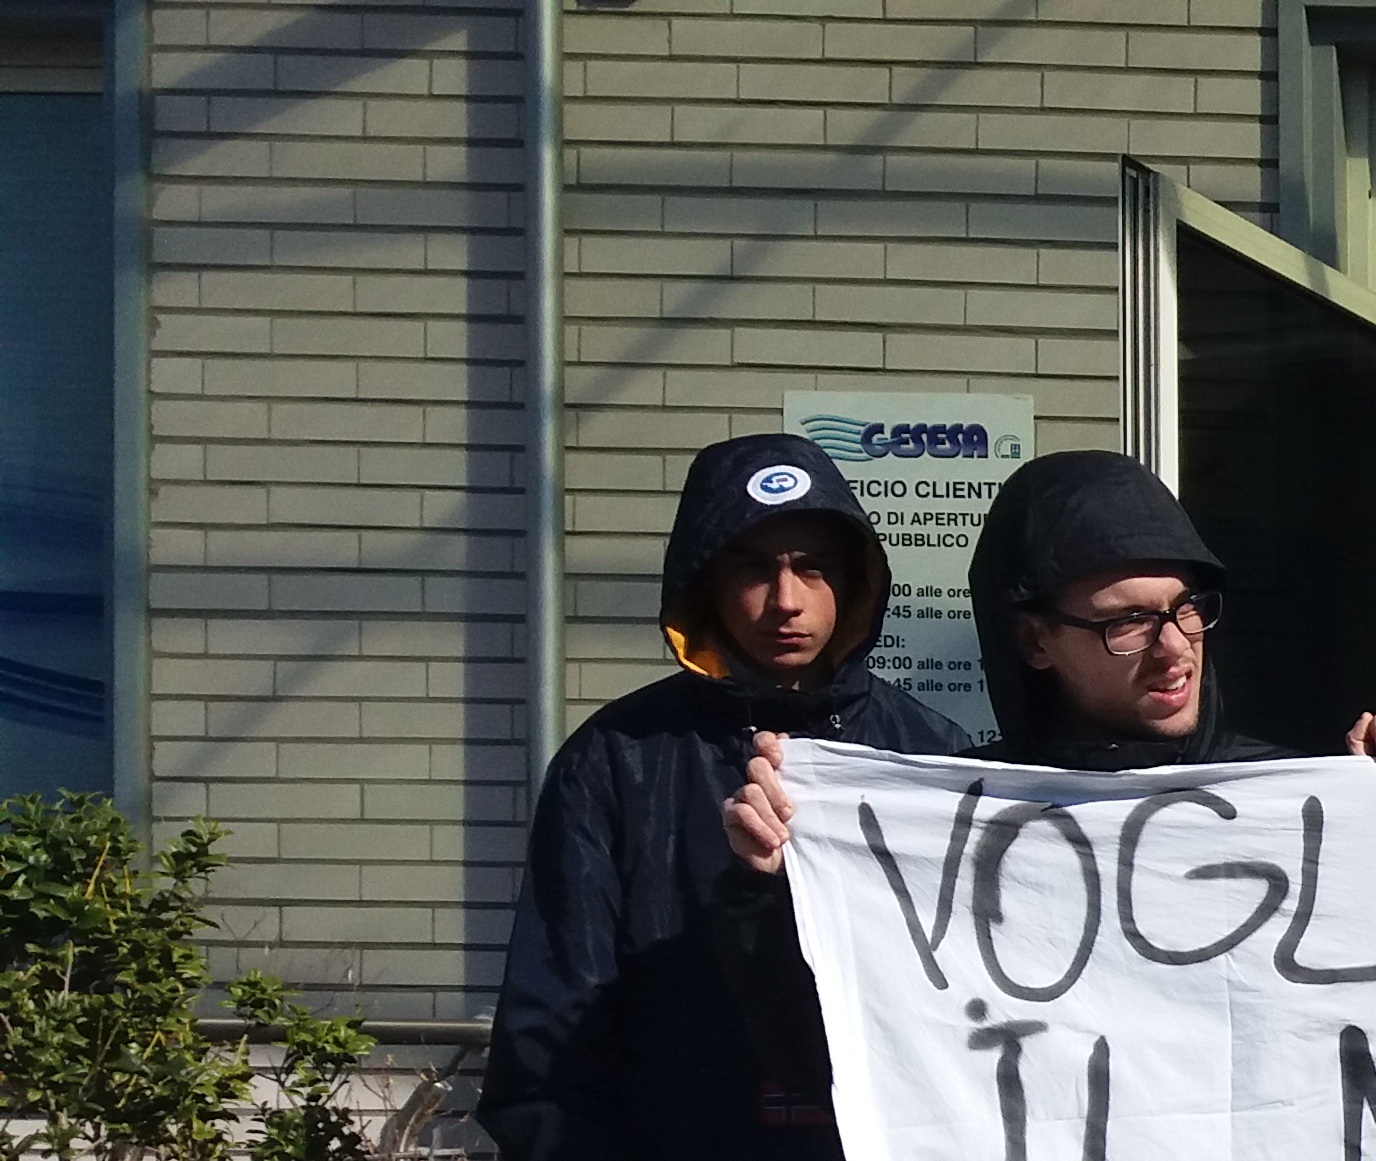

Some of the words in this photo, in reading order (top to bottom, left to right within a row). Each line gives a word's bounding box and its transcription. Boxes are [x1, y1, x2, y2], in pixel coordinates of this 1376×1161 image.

[861, 422, 988, 458] GESESA
[887, 511, 904, 525] DI
[877, 533, 969, 547] PUBBLICO
[916, 585, 942, 598] alle
[947, 588, 971, 598] ore
[916, 606, 942, 619] alle
[947, 609, 971, 619] ore
[866, 656, 912, 669] 09:00
[917, 658, 943, 670] alle
[948, 660, 972, 670] ore
[917, 679, 943, 691] alle
[948, 682, 972, 692] ore
